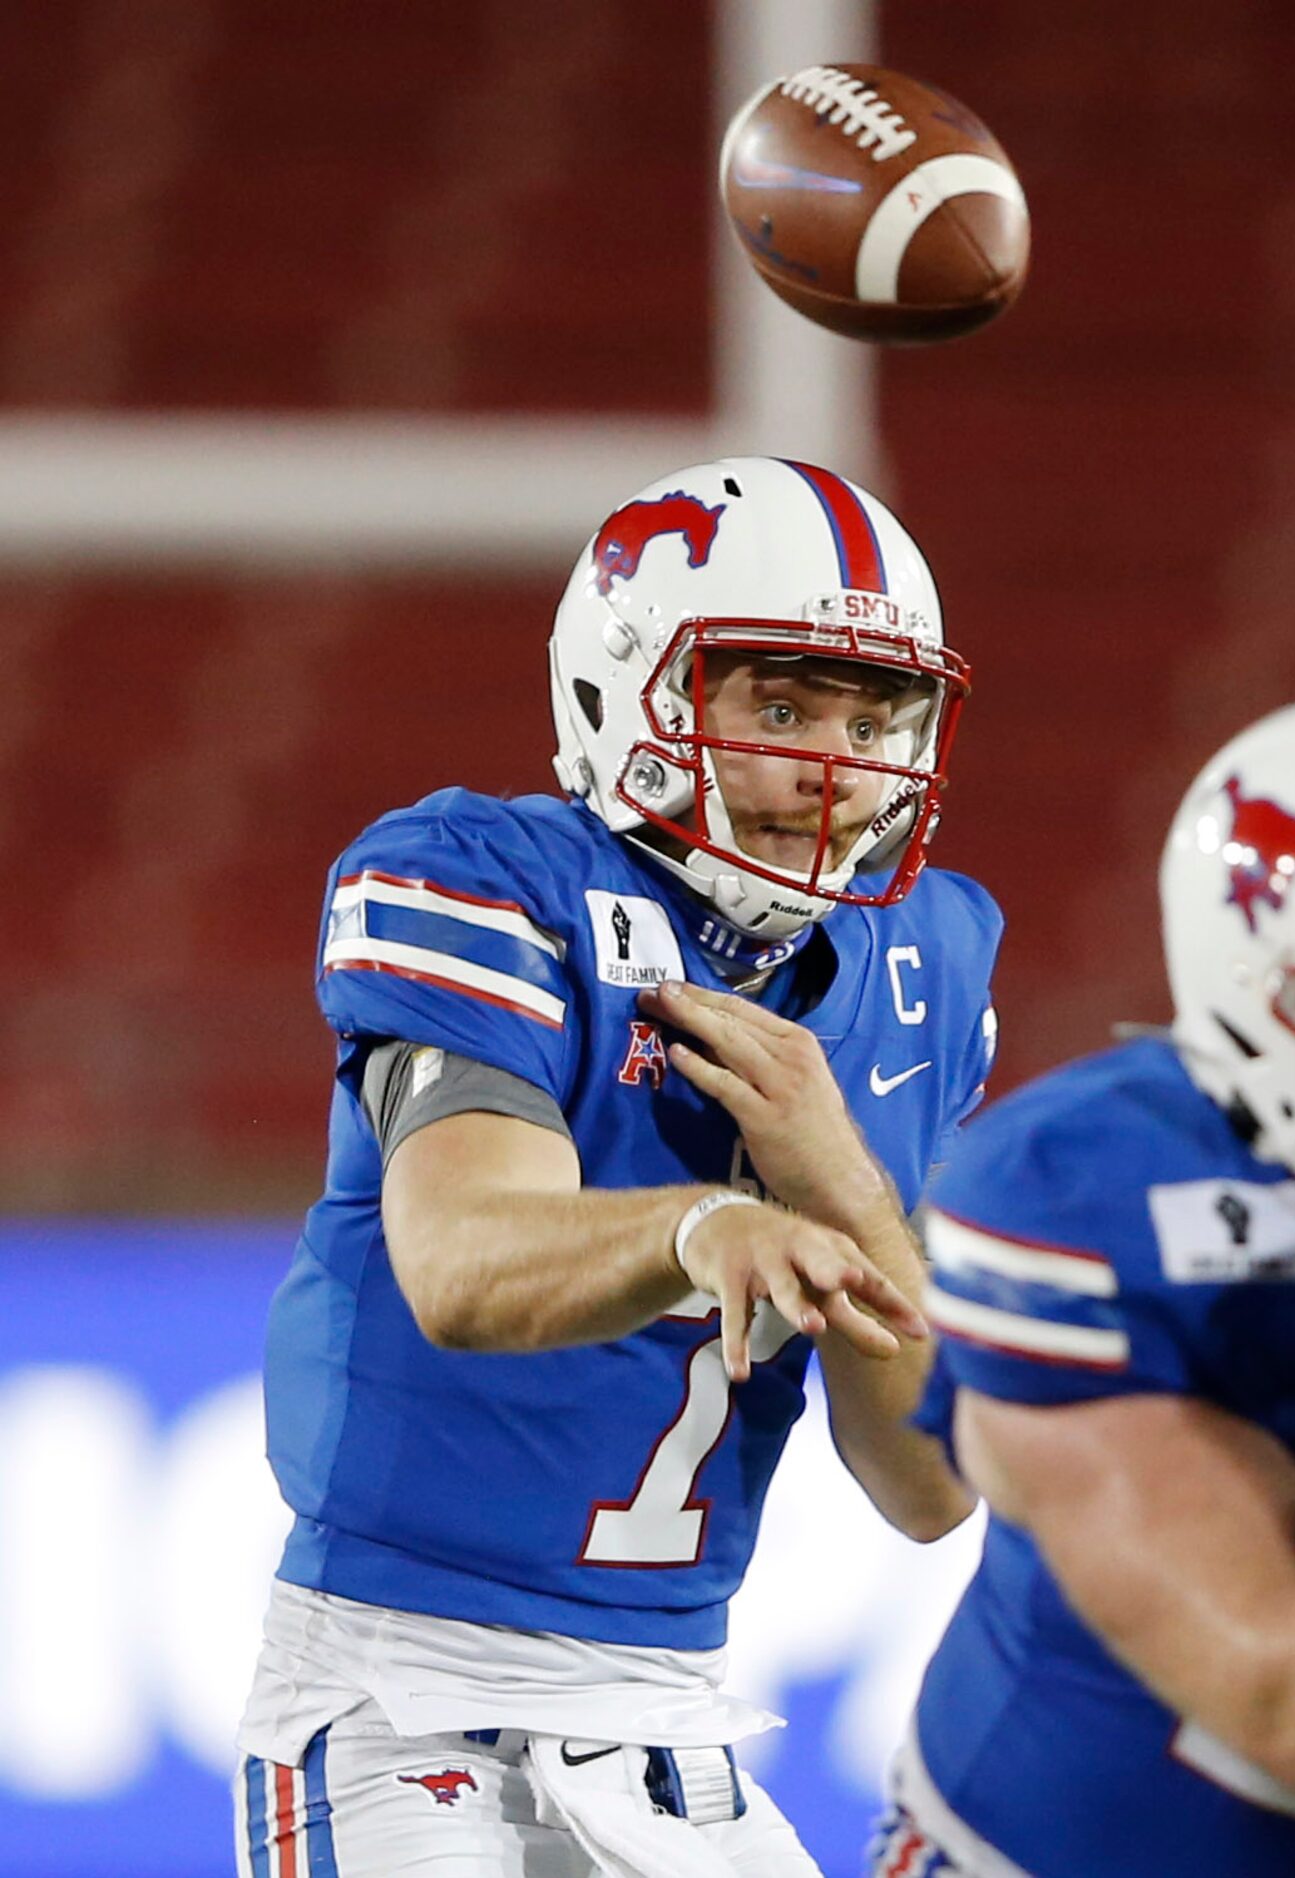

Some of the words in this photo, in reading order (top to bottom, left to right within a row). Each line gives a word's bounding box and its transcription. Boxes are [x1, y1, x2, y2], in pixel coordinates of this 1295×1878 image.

[843, 595, 899, 627] SMU
[871, 776, 922, 838] Riddel
[769, 900, 813, 917] Riddell
[625, 965, 668, 984] FAMILY
[886, 945, 927, 1025] C
